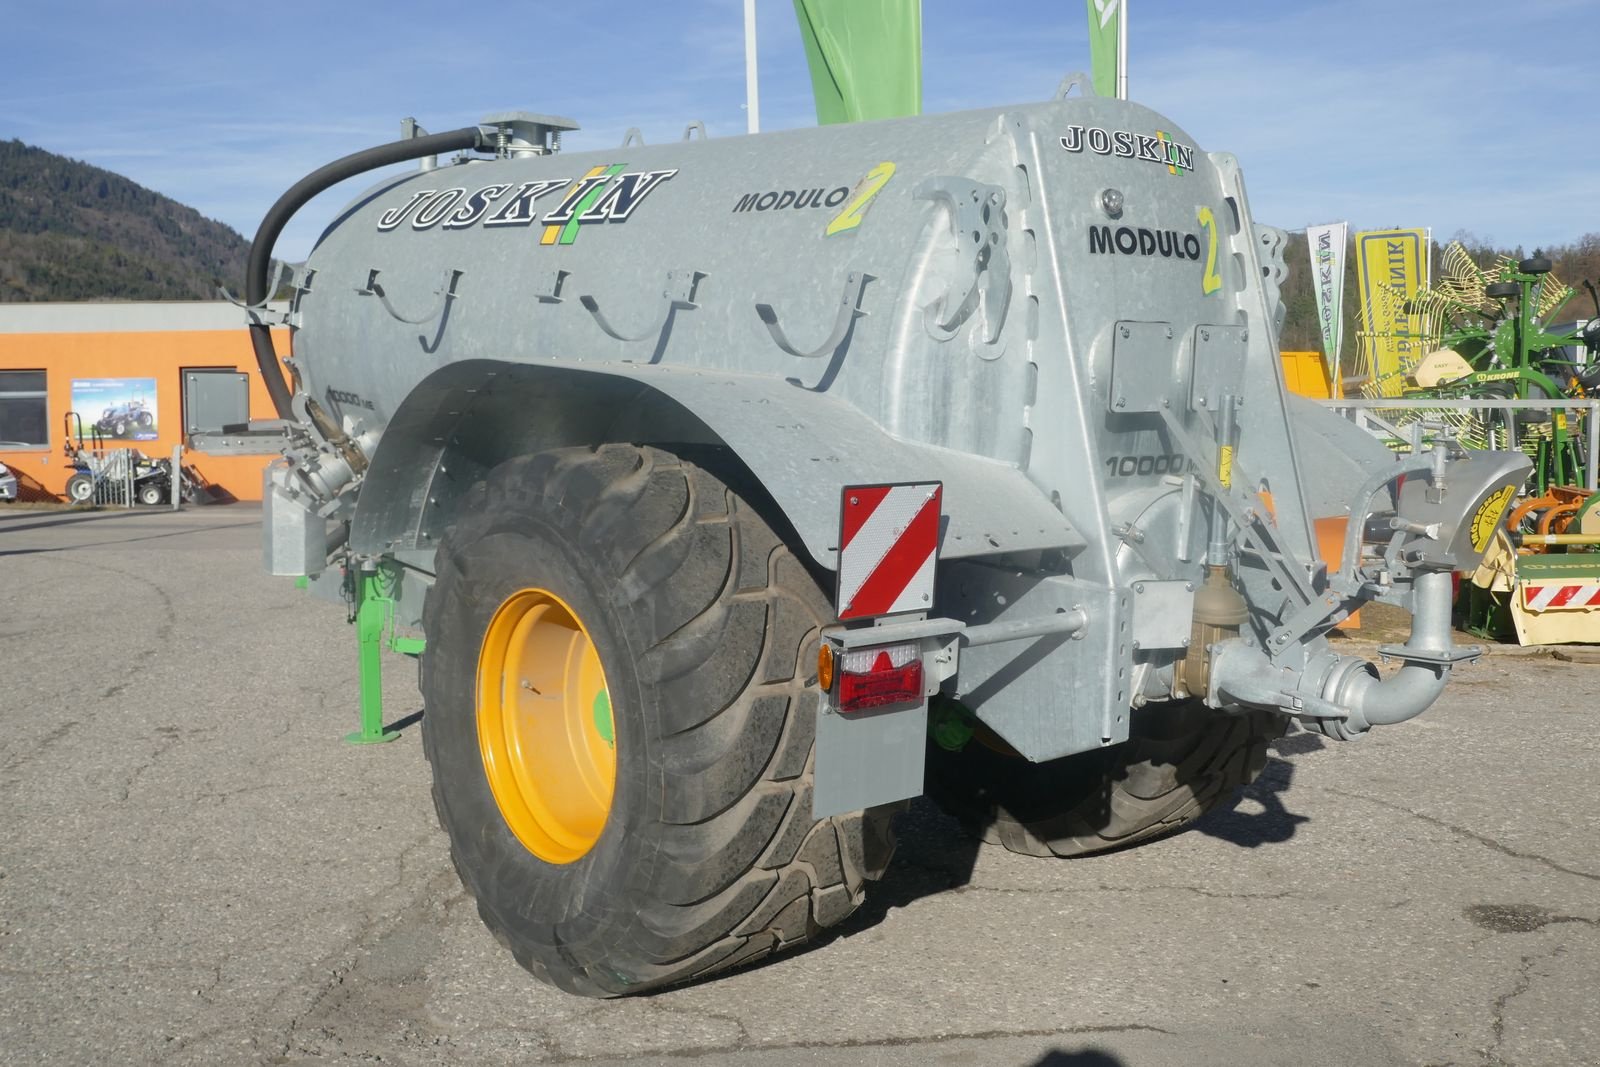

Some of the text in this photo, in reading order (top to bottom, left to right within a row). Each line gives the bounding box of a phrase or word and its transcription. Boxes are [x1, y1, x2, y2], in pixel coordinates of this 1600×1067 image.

[1060, 125, 1194, 171] JOSKIN
[377, 168, 679, 232] JOSKIN
[732, 161, 897, 238] MODULO 2
[1089, 207, 1222, 296] MODULO 2
[1487, 371, 1520, 381] KRONE
[1105, 453, 1185, 477] 10000
